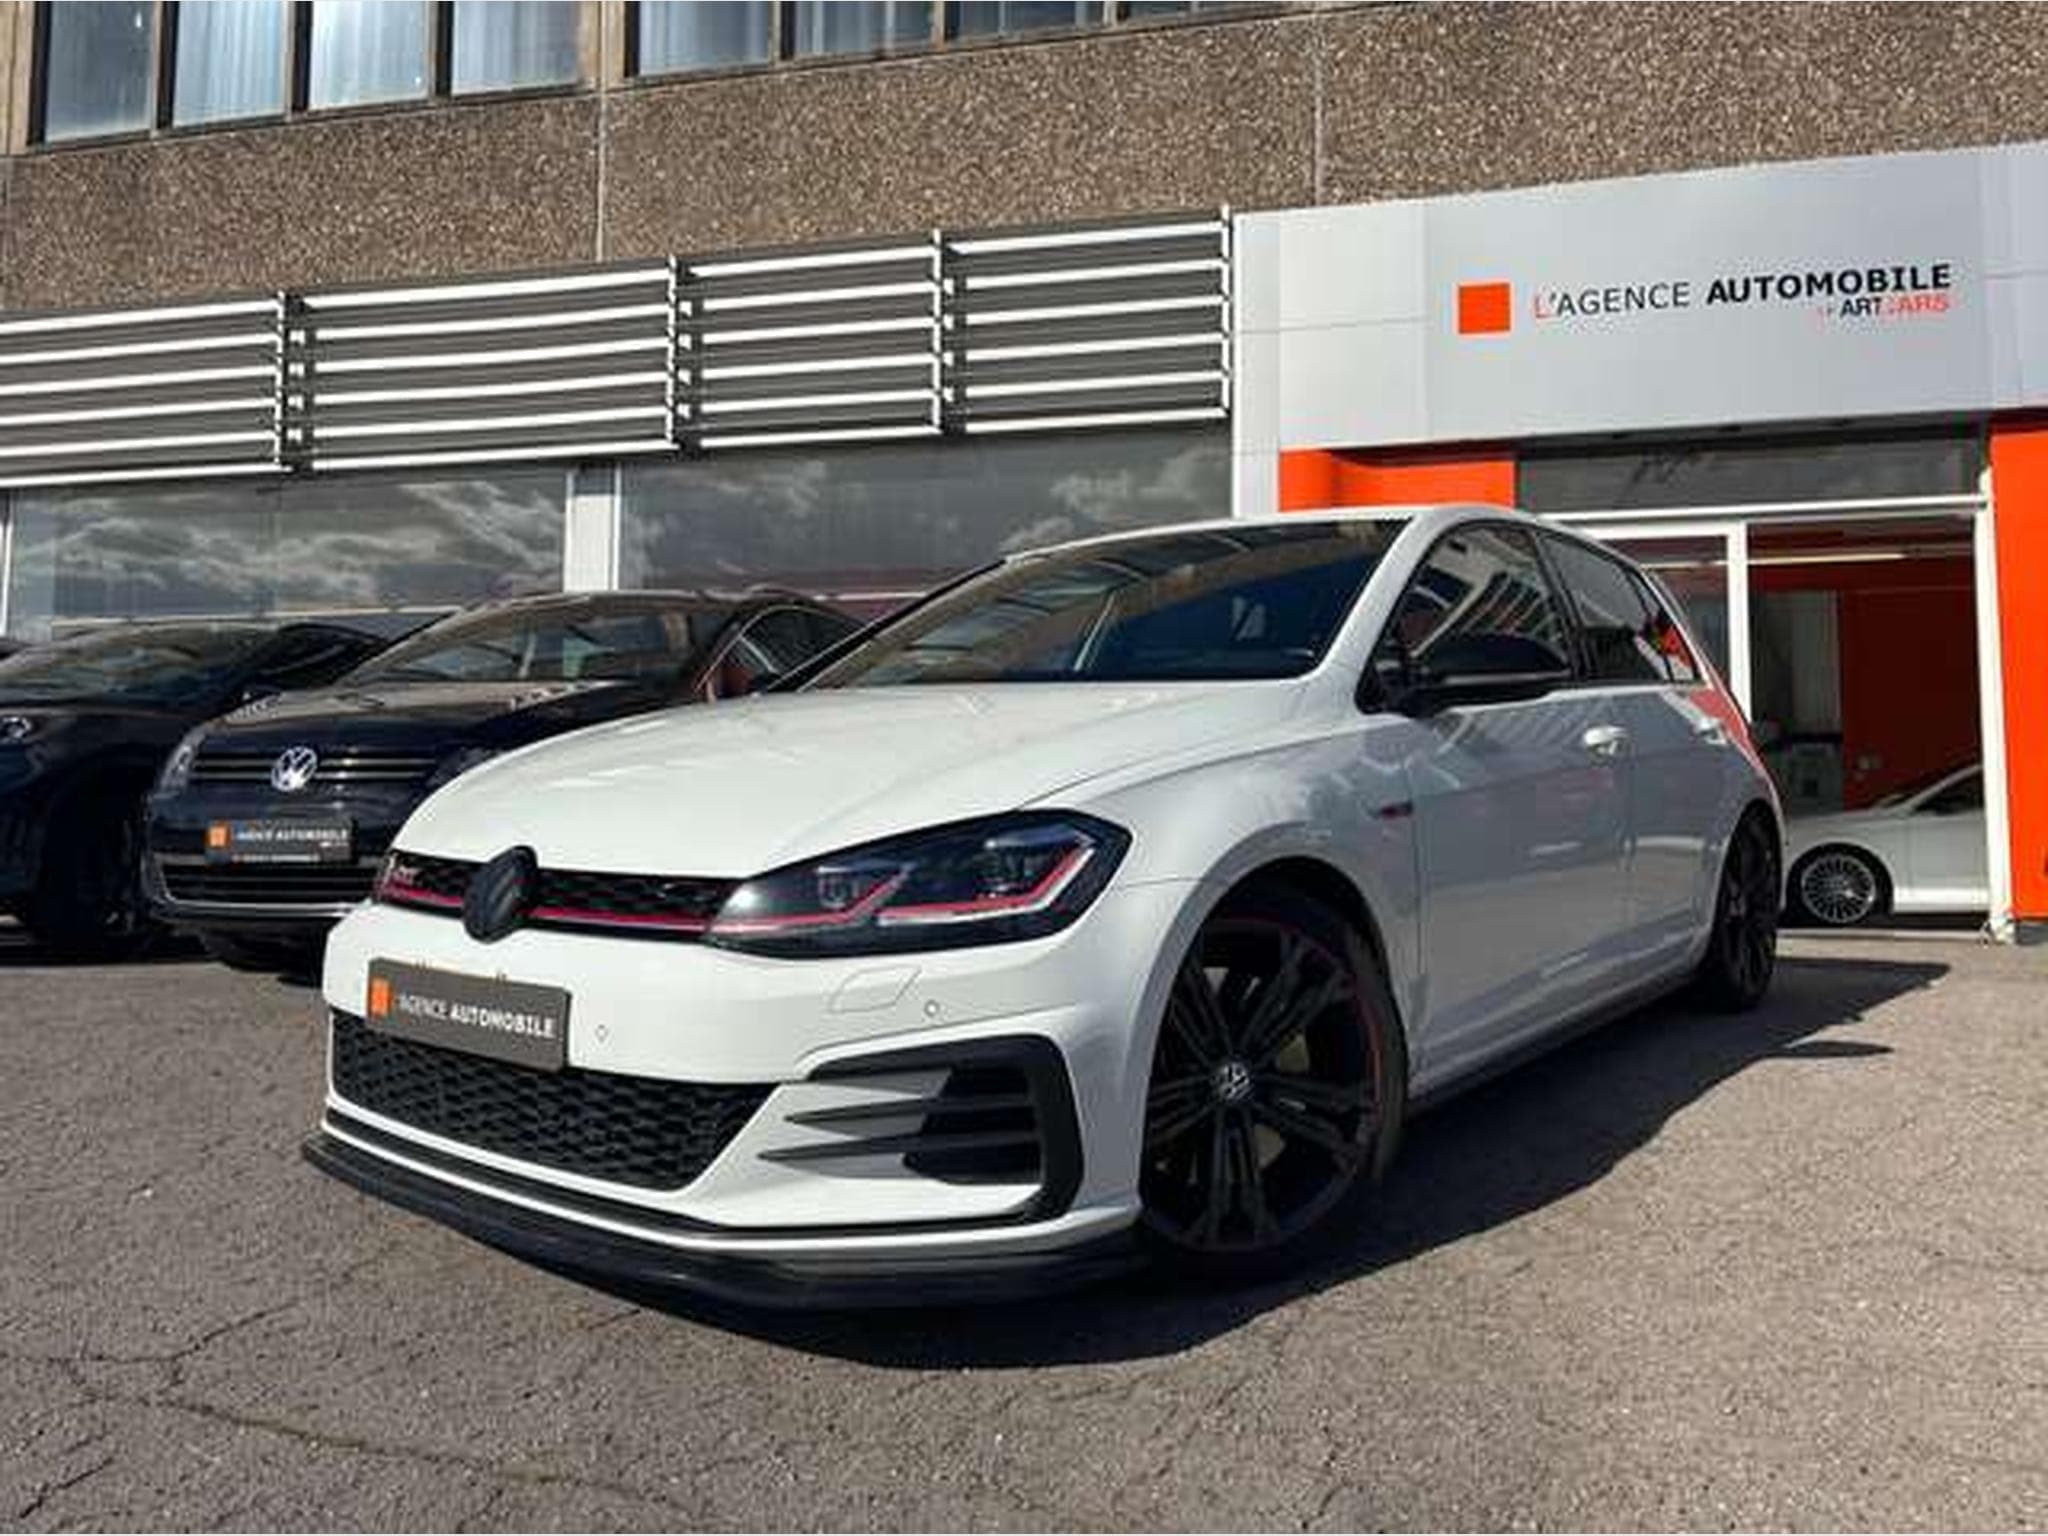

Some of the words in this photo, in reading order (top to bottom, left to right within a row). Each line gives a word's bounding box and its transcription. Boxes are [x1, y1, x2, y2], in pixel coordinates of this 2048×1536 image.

[1534, 282, 1690, 318] L'AGENCE
[1706, 264, 1951, 304] AUTOMOBILE
[450, 1003, 556, 1038] AUTOMOBILE
